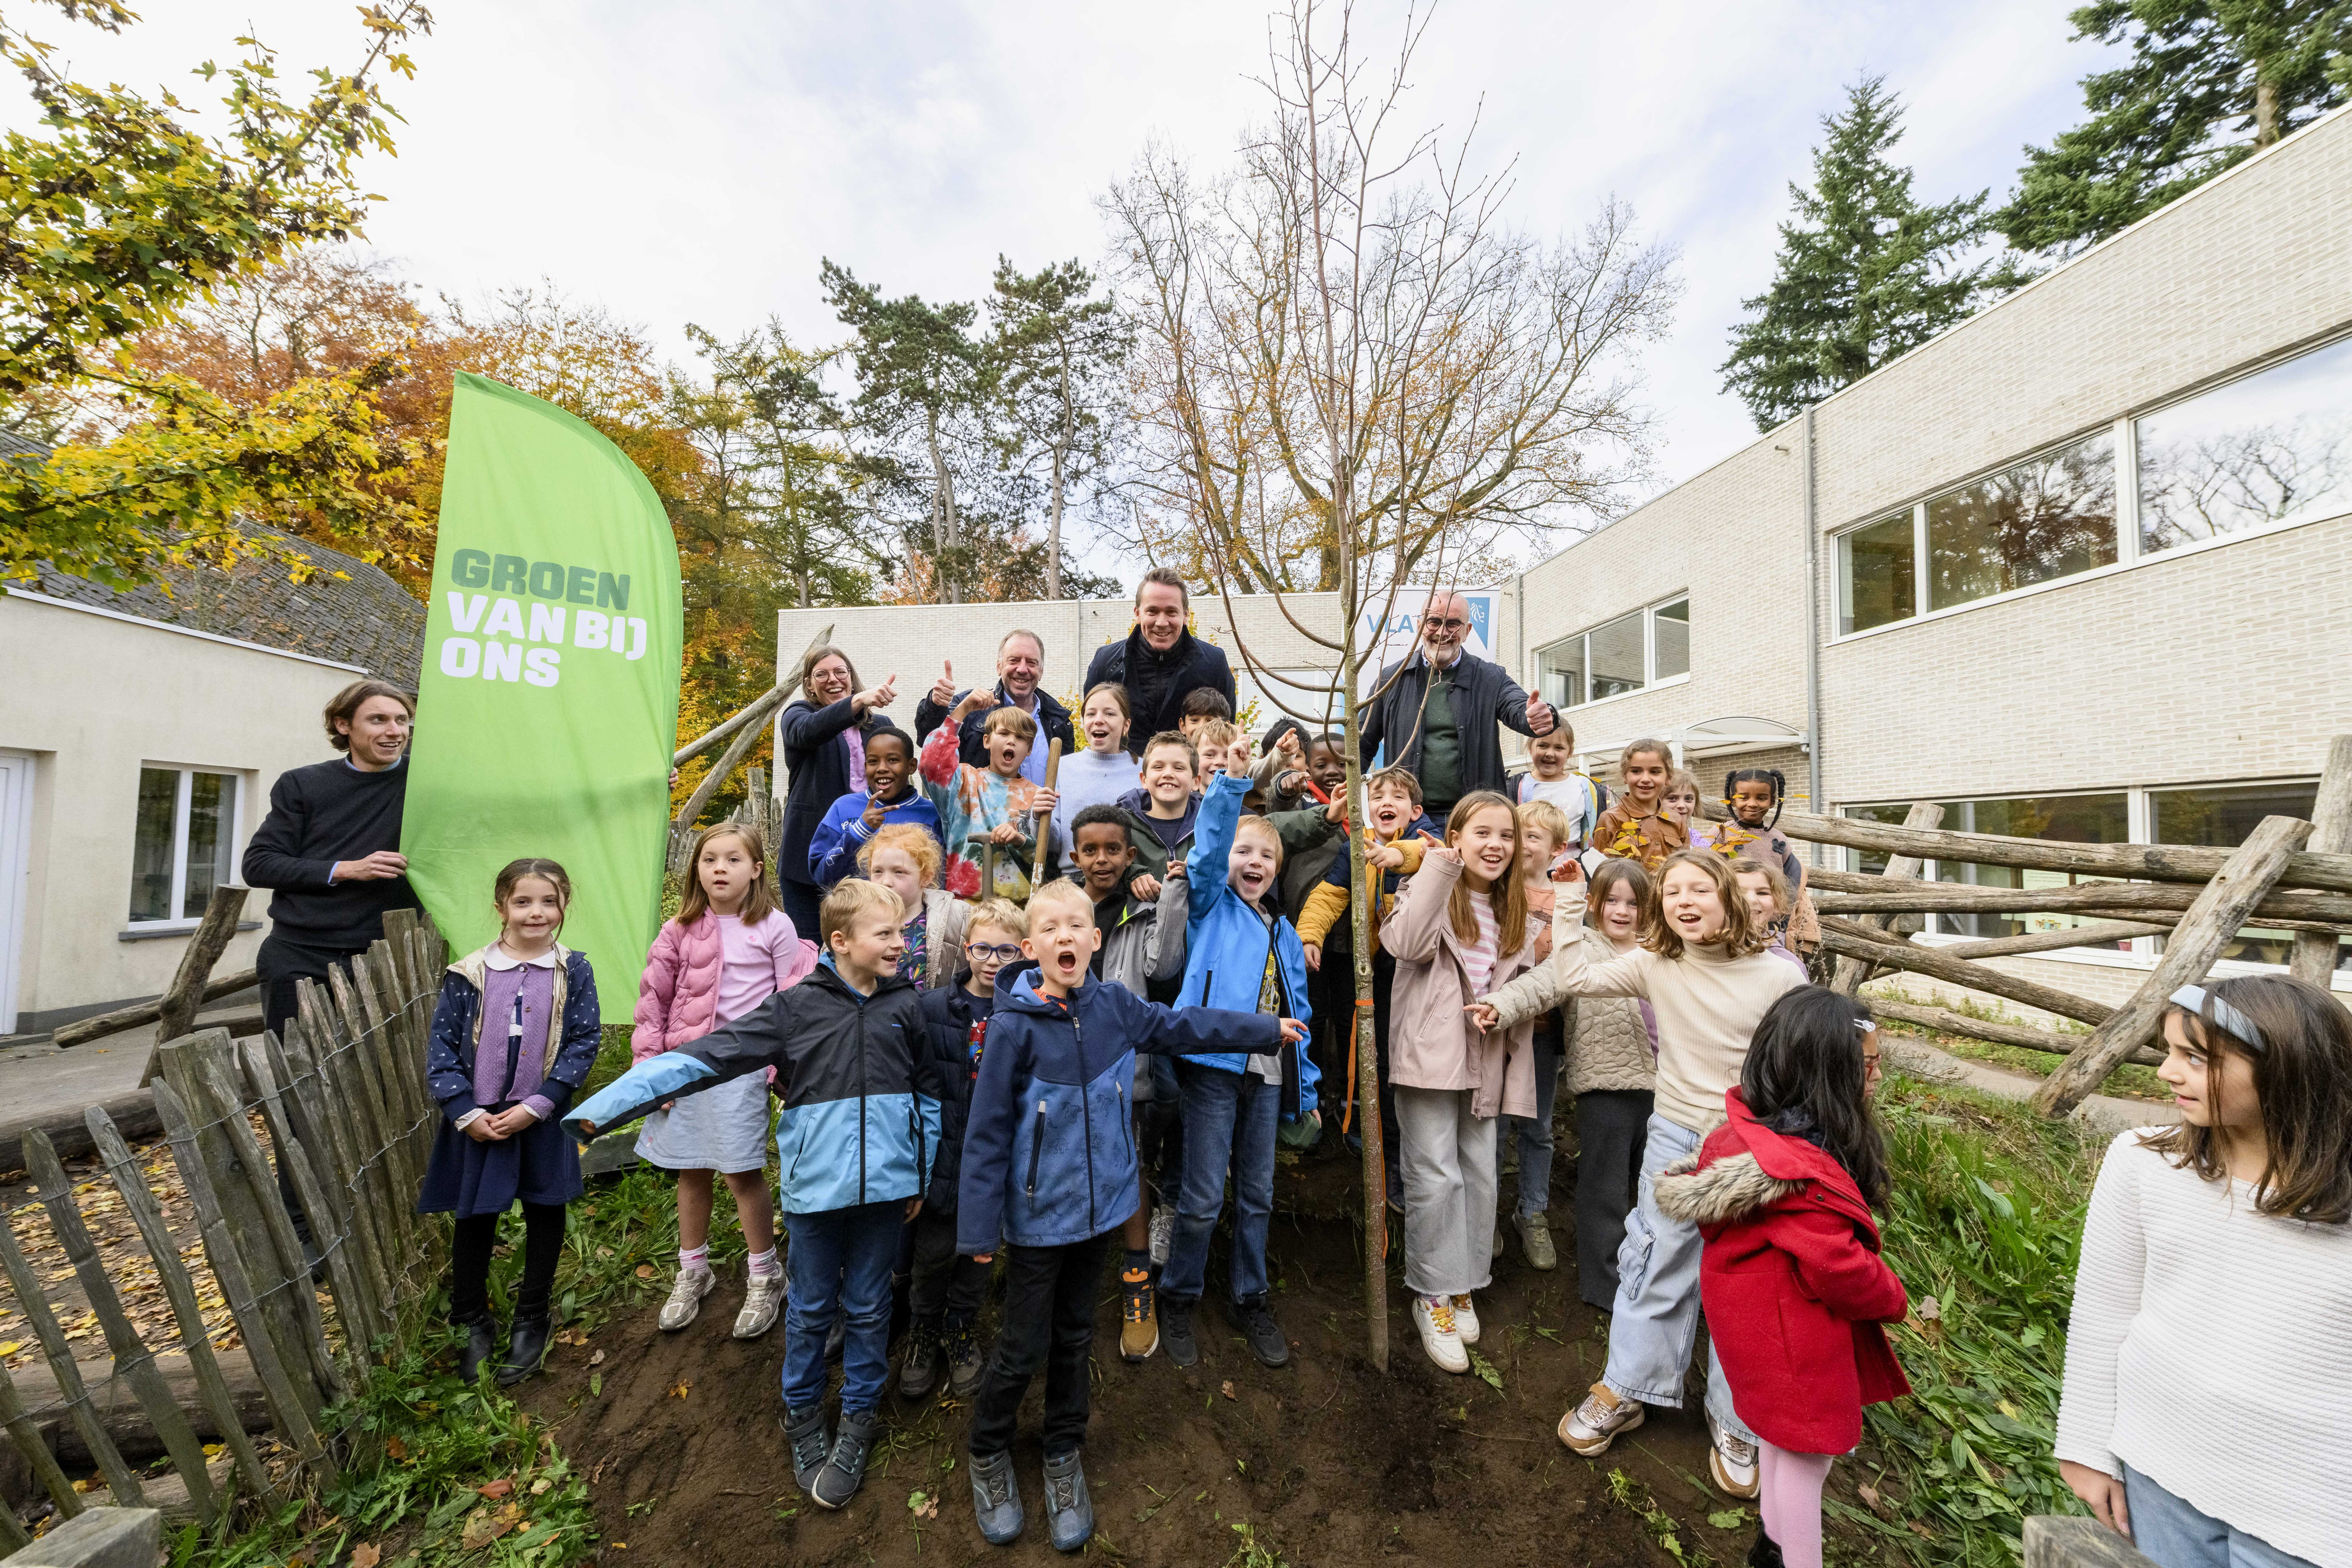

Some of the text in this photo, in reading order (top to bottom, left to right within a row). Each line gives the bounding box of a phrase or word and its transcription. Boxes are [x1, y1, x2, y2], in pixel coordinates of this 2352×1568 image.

[451, 549, 630, 610] GROEN
[447, 591, 647, 661] VAN BIJ
[1367, 614, 1419, 633] VLA
[440, 637, 560, 687] ONS
